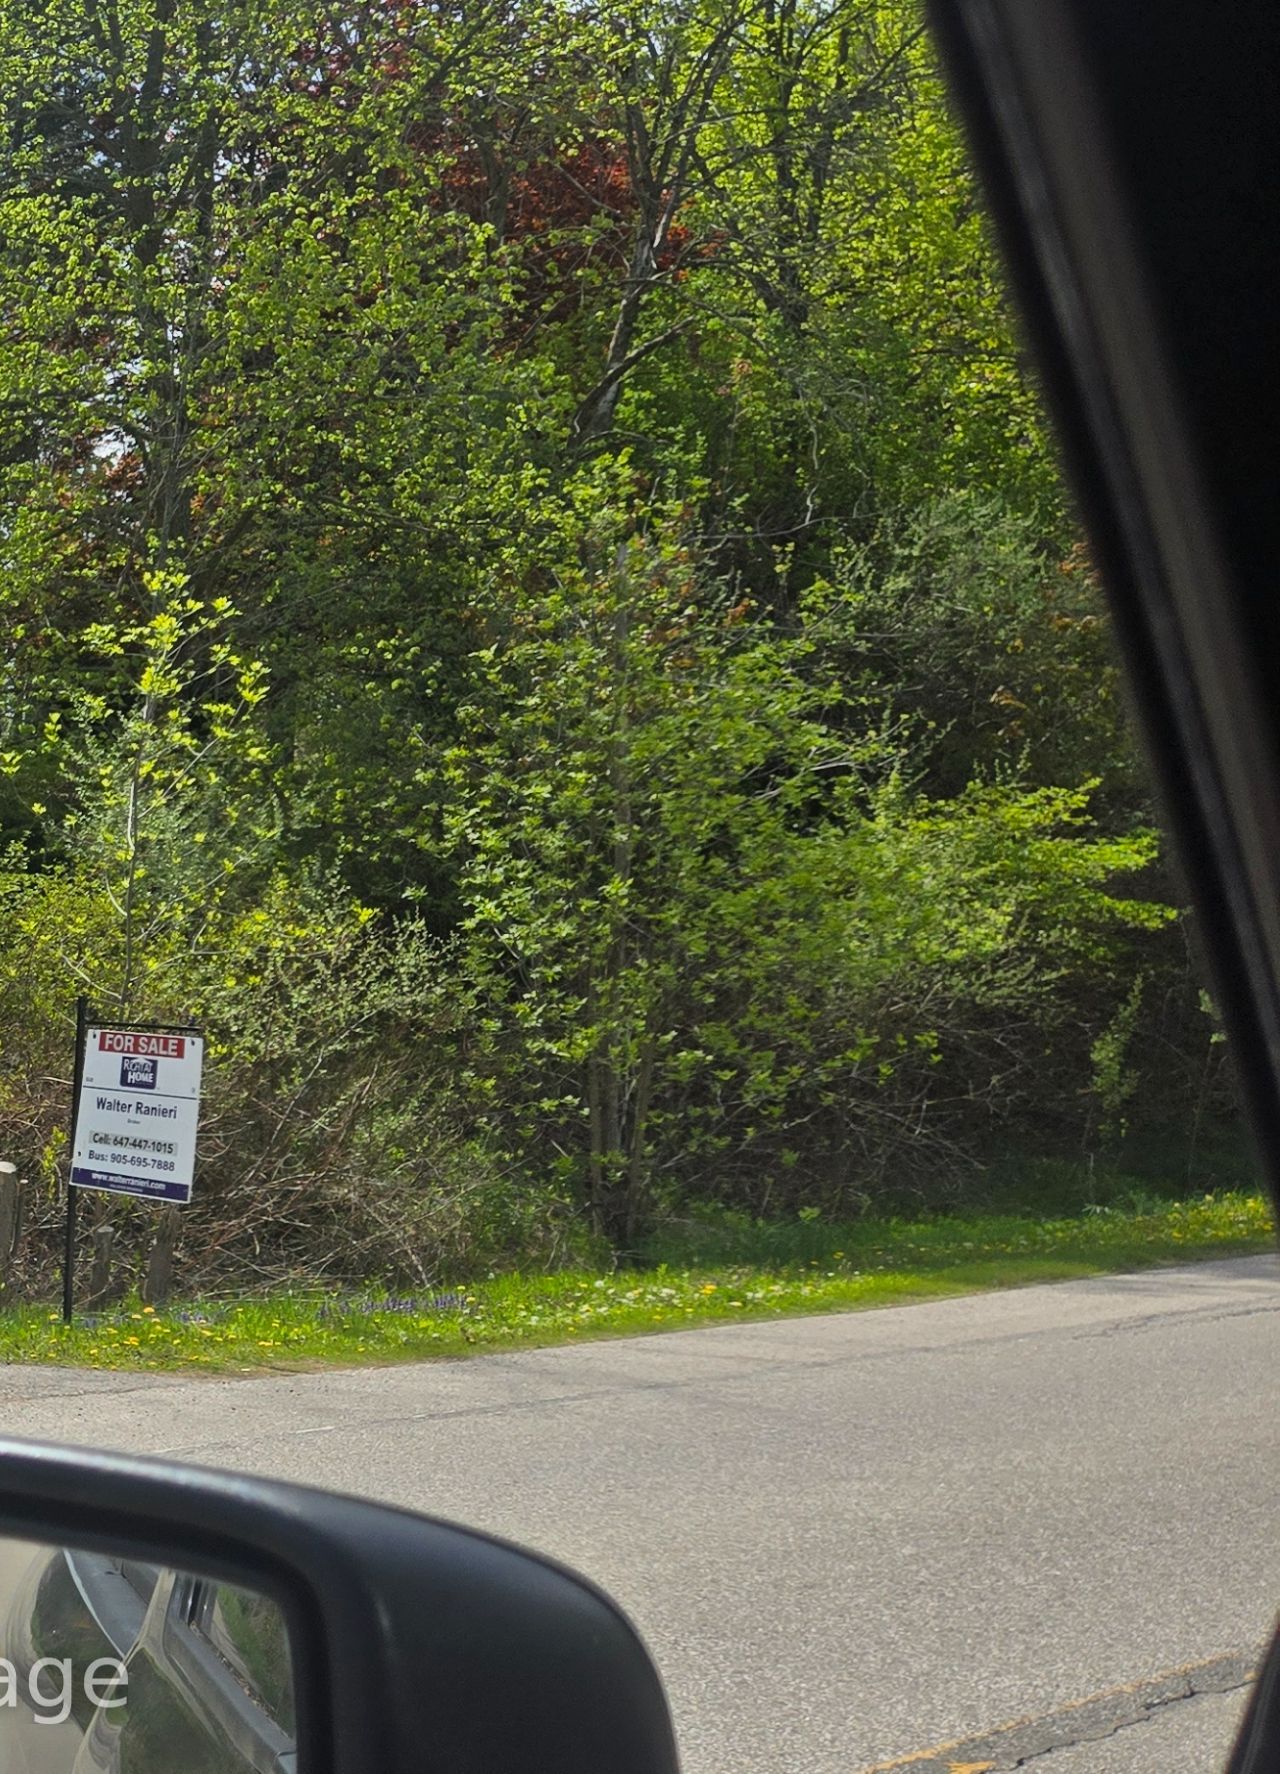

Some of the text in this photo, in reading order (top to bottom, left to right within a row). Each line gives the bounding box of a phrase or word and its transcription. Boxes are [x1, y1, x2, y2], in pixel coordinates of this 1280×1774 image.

[104, 1033, 178, 1056] FOR SALE
[127, 1070, 154, 1084] HOME
[96, 1096, 178, 1119] Walter Ranieri
[92, 1132, 174, 1154] Cell: 647-447-1015
[88, 1149, 175, 1172] Bus: 905-695-7888
